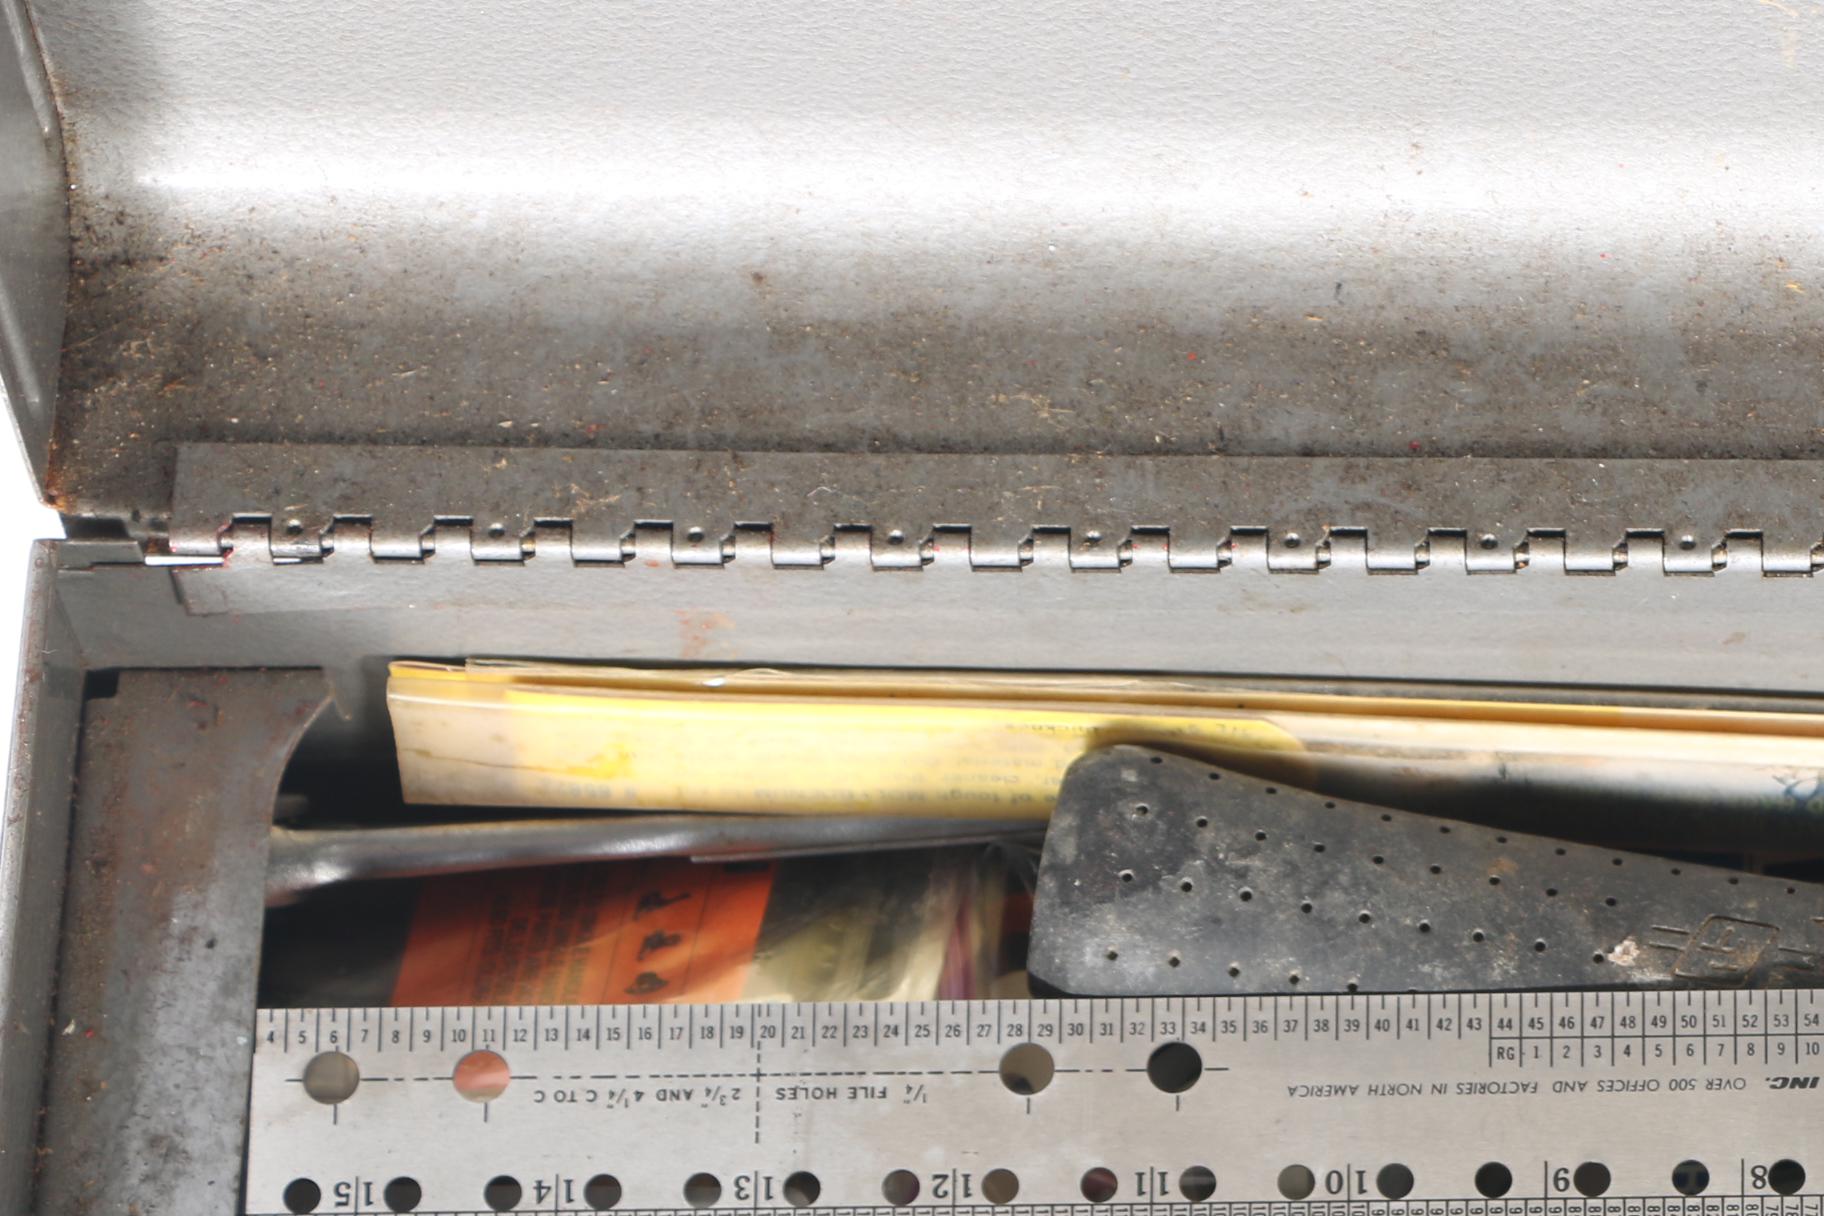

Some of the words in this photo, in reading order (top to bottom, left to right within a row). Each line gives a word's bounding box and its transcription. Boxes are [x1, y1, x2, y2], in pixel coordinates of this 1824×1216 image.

[267, 1031, 275, 1044] 4
[391, 1029, 400, 1044] 8
[545, 1027, 559, 1042] 13
[639, 1027, 653, 1041] 16
[730, 1025, 745, 1039] 19
[883, 1024, 899, 1039] 24
[1007, 1023, 1023, 1037] 28
[1099, 1022, 1113, 1037] 31
[1252, 1019, 1269, 1034] 36
[1373, 1018, 1391, 1033] 40
[1497, 1017, 1513, 1031] 44
[1619, 1015, 1637, 1029] 48
[1741, 1014, 1759, 1029] 52
[1497, 1045, 1515, 1061] RG
[1533, 1045, 1539, 1059] 1
[1623, 1043, 1631, 1057] 4
[1717, 1043, 1725, 1057] 7
[1805, 1041, 1820, 1056] 10
[1368, 1082, 1422, 1097] NORTH
[1431, 1083, 1448, 1096] IN
[1456, 1080, 1538, 1096] FACTORIES
[1552, 1080, 1588, 1093] AND
[1596, 1079, 1660, 1093] OFFICES
[1668, 1078, 1696, 1091] 500
[1705, 1077, 1746, 1091] OVER
[1764, 1076, 1820, 1089] INC.
[534, 1090, 545, 1102] C
[554, 1089, 577, 1102] TO
[586, 1090, 597, 1102] C
[656, 1088, 693, 1101] AND
[775, 1086, 836, 1100] HOLES
[847, 1086, 887, 1100] FILE
[1287, 1083, 1360, 1097] AMERICA
[1553, 1167, 1571, 1194] 9
[1750, 1163, 1768, 1190] 8
